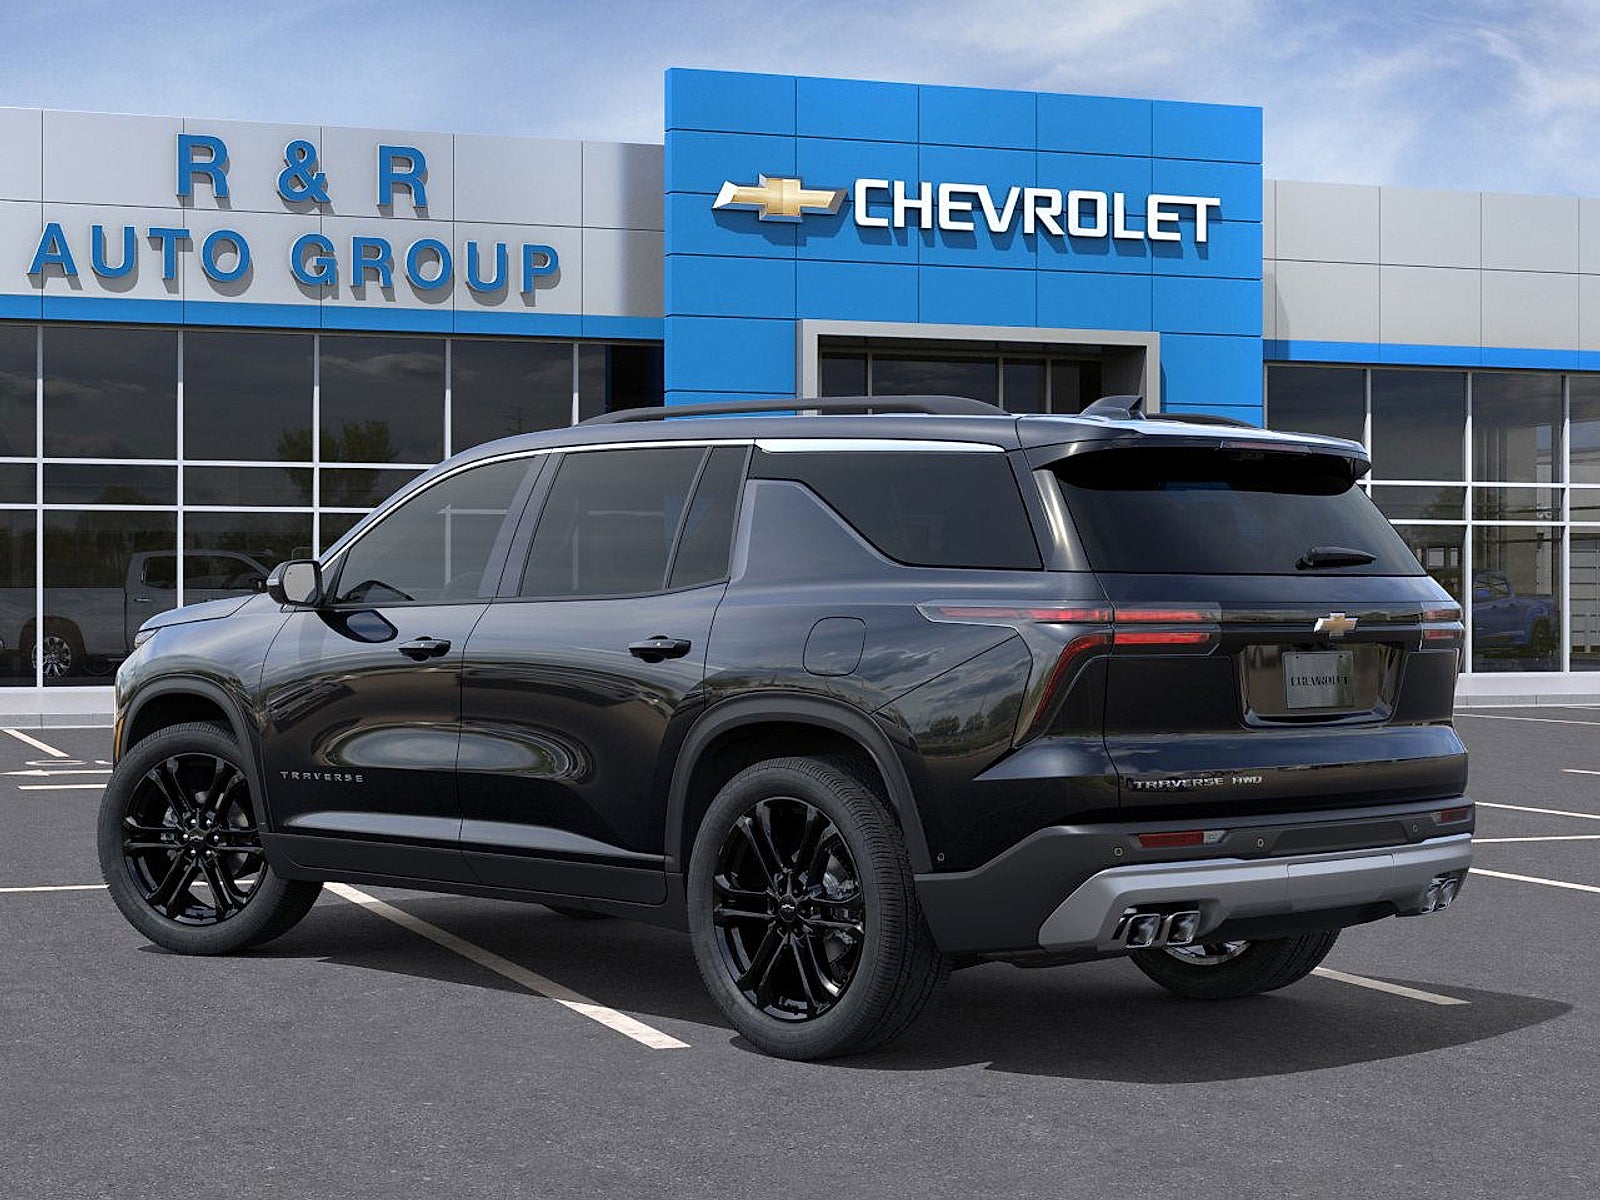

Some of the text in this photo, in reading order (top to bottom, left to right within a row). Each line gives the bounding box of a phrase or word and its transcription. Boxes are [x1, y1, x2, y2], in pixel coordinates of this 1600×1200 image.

[176, 133, 429, 208] R & R
[853, 178, 1221, 243] CHEVROLET
[28, 222, 561, 294] AUTO GROUP
[280, 771, 364, 783] TRAVERSE
[1132, 776, 1263, 790] TRAVERSE AWD
